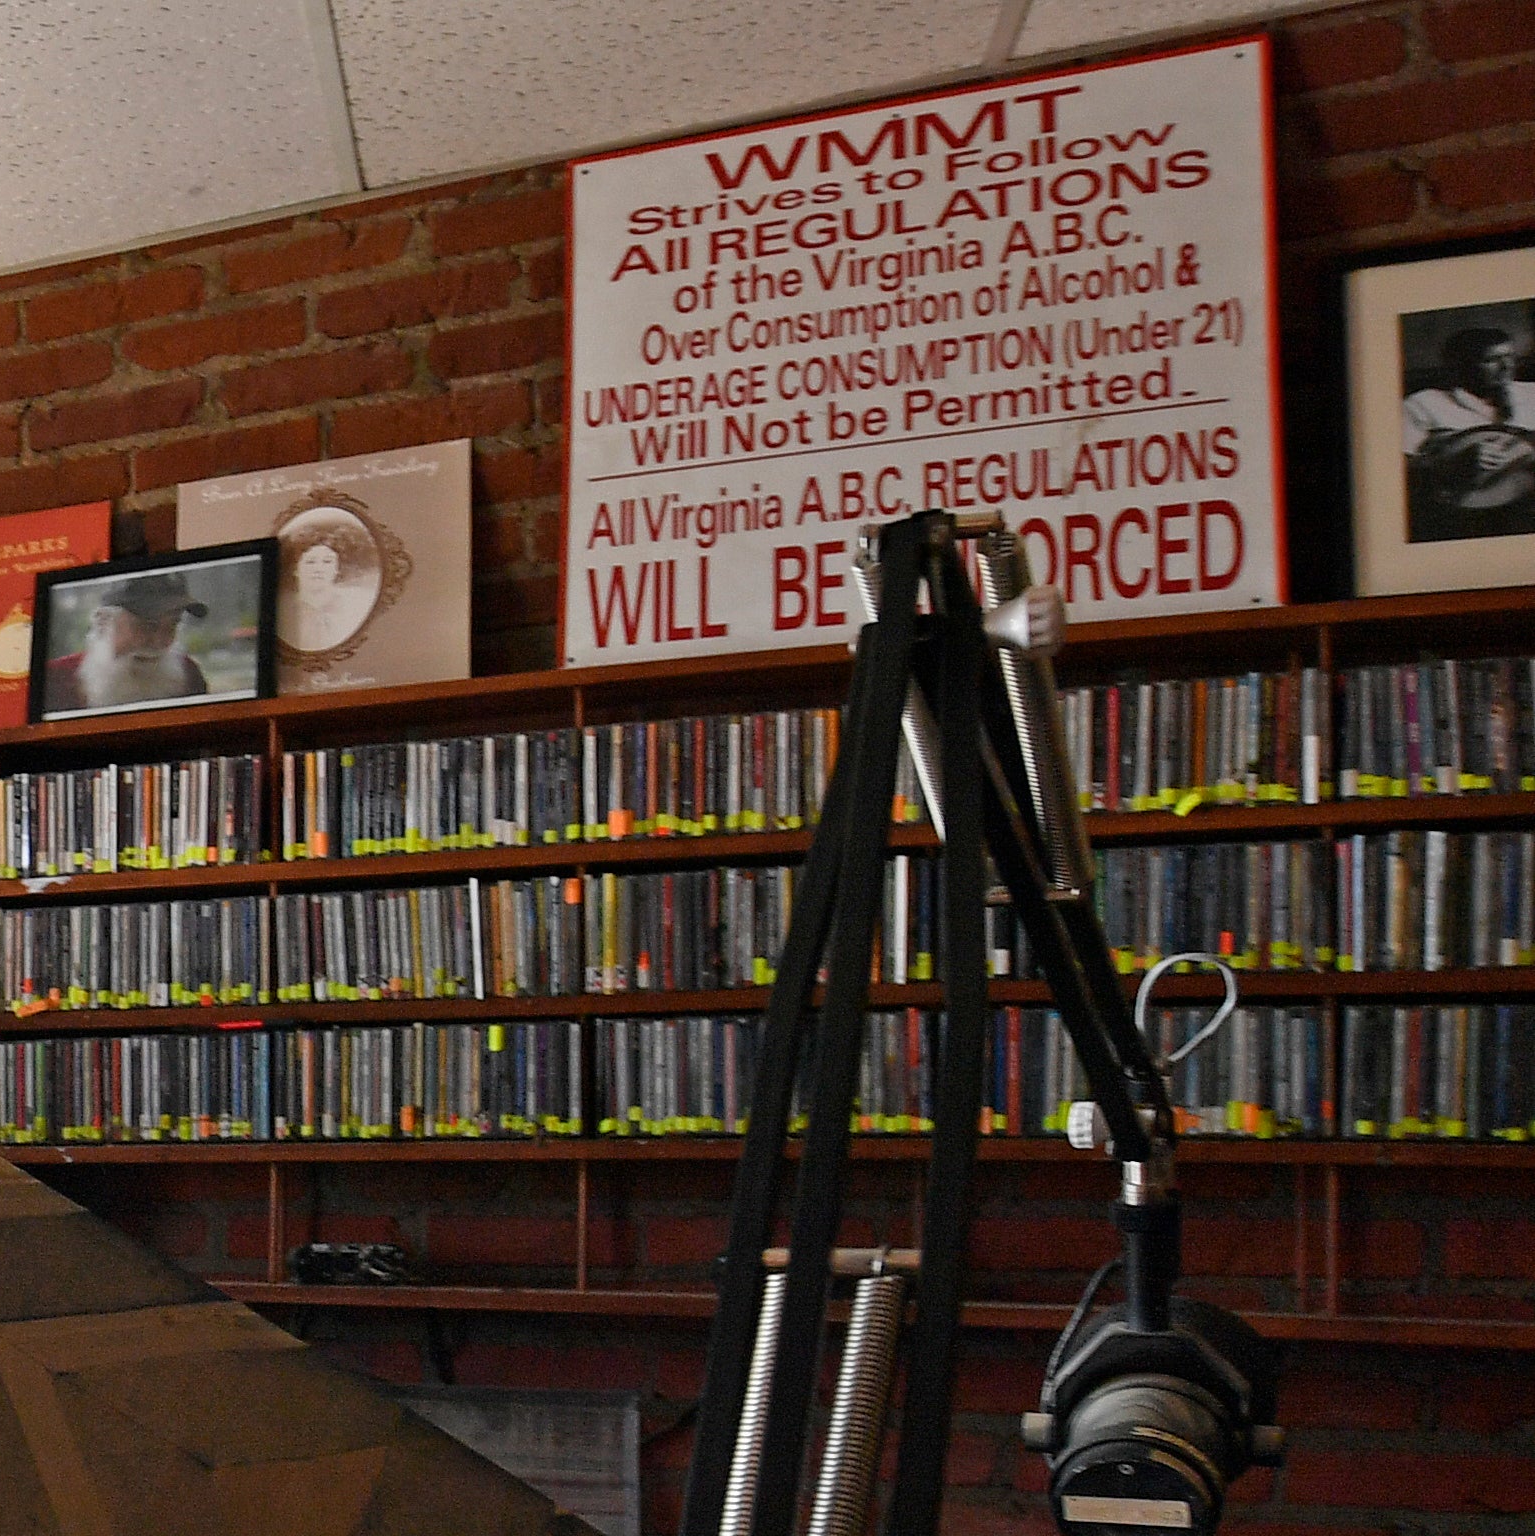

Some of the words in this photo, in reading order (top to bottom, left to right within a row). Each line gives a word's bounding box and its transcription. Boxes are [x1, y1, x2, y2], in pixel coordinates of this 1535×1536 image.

[627, 182, 843, 236] Strives
[855, 167, 925, 195] to
[943, 122, 1177, 182] Follow
[704, 86, 1082, 191] WMMT
[610, 237, 691, 282] All
[708, 150, 1213, 266] REGULATIONS
[673, 270, 718, 314] of
[730, 264, 803, 303] the
[812, 230, 985, 292] Virginia
[999, 204, 1145, 264] A.B.C.
[640, 322, 721, 367] Over
[725, 282, 963, 354] Consumption
[973, 269, 1011, 318] of
[1017, 247, 1165, 312] Alcohol
[1174, 242, 1201, 286] &
[583, 364, 769, 428] UNDERAGE
[777, 322, 1056, 402] CONSUMPTION
[1063, 310, 1187, 369] (Under
[1191, 297, 1246, 348] 21)
[586, 498, 637, 551] All
[640, 483, 786, 548] Virginia
[794, 466, 914, 526] A.B.C.
[922, 425, 1241, 512] REGULATIONS
[629, 418, 708, 467] Will
[722, 408, 813, 456] Not
[828, 399, 890, 442] be
[586, 555, 730, 650] WILL
[771, 540, 850, 631] BE
